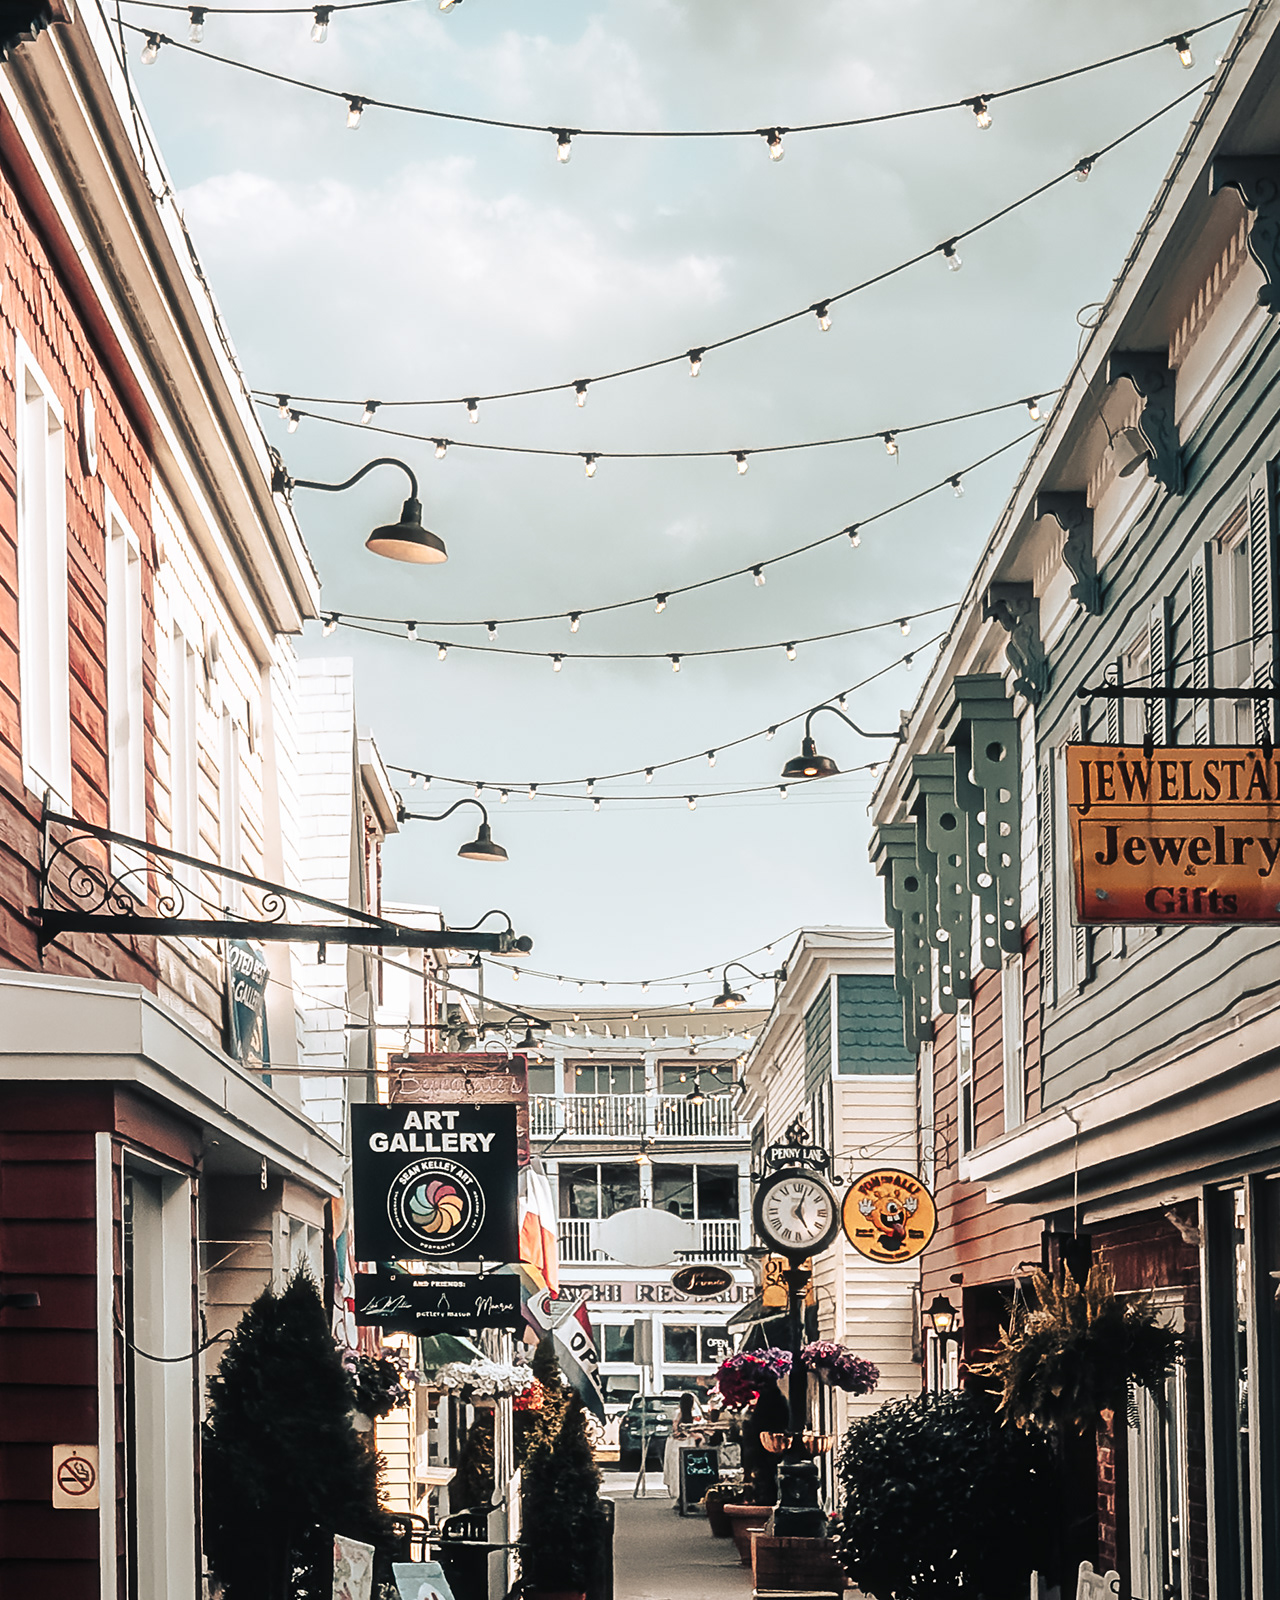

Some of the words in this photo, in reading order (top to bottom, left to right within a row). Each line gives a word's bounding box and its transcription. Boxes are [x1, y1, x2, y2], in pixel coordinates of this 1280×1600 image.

[1183, 864, 1197, 877] &
[1144, 886, 1239, 915] Gifts
[403, 1110, 460, 1131] ART
[369, 1132, 496, 1153] GALLERY
[771, 1147, 801, 1162] PENNY
[802, 1148, 826, 1163] LANE
[399, 1165, 421, 1186] SEAN
[421, 1160, 458, 1174] KELLEY
[455, 1168, 475, 1186] ART
